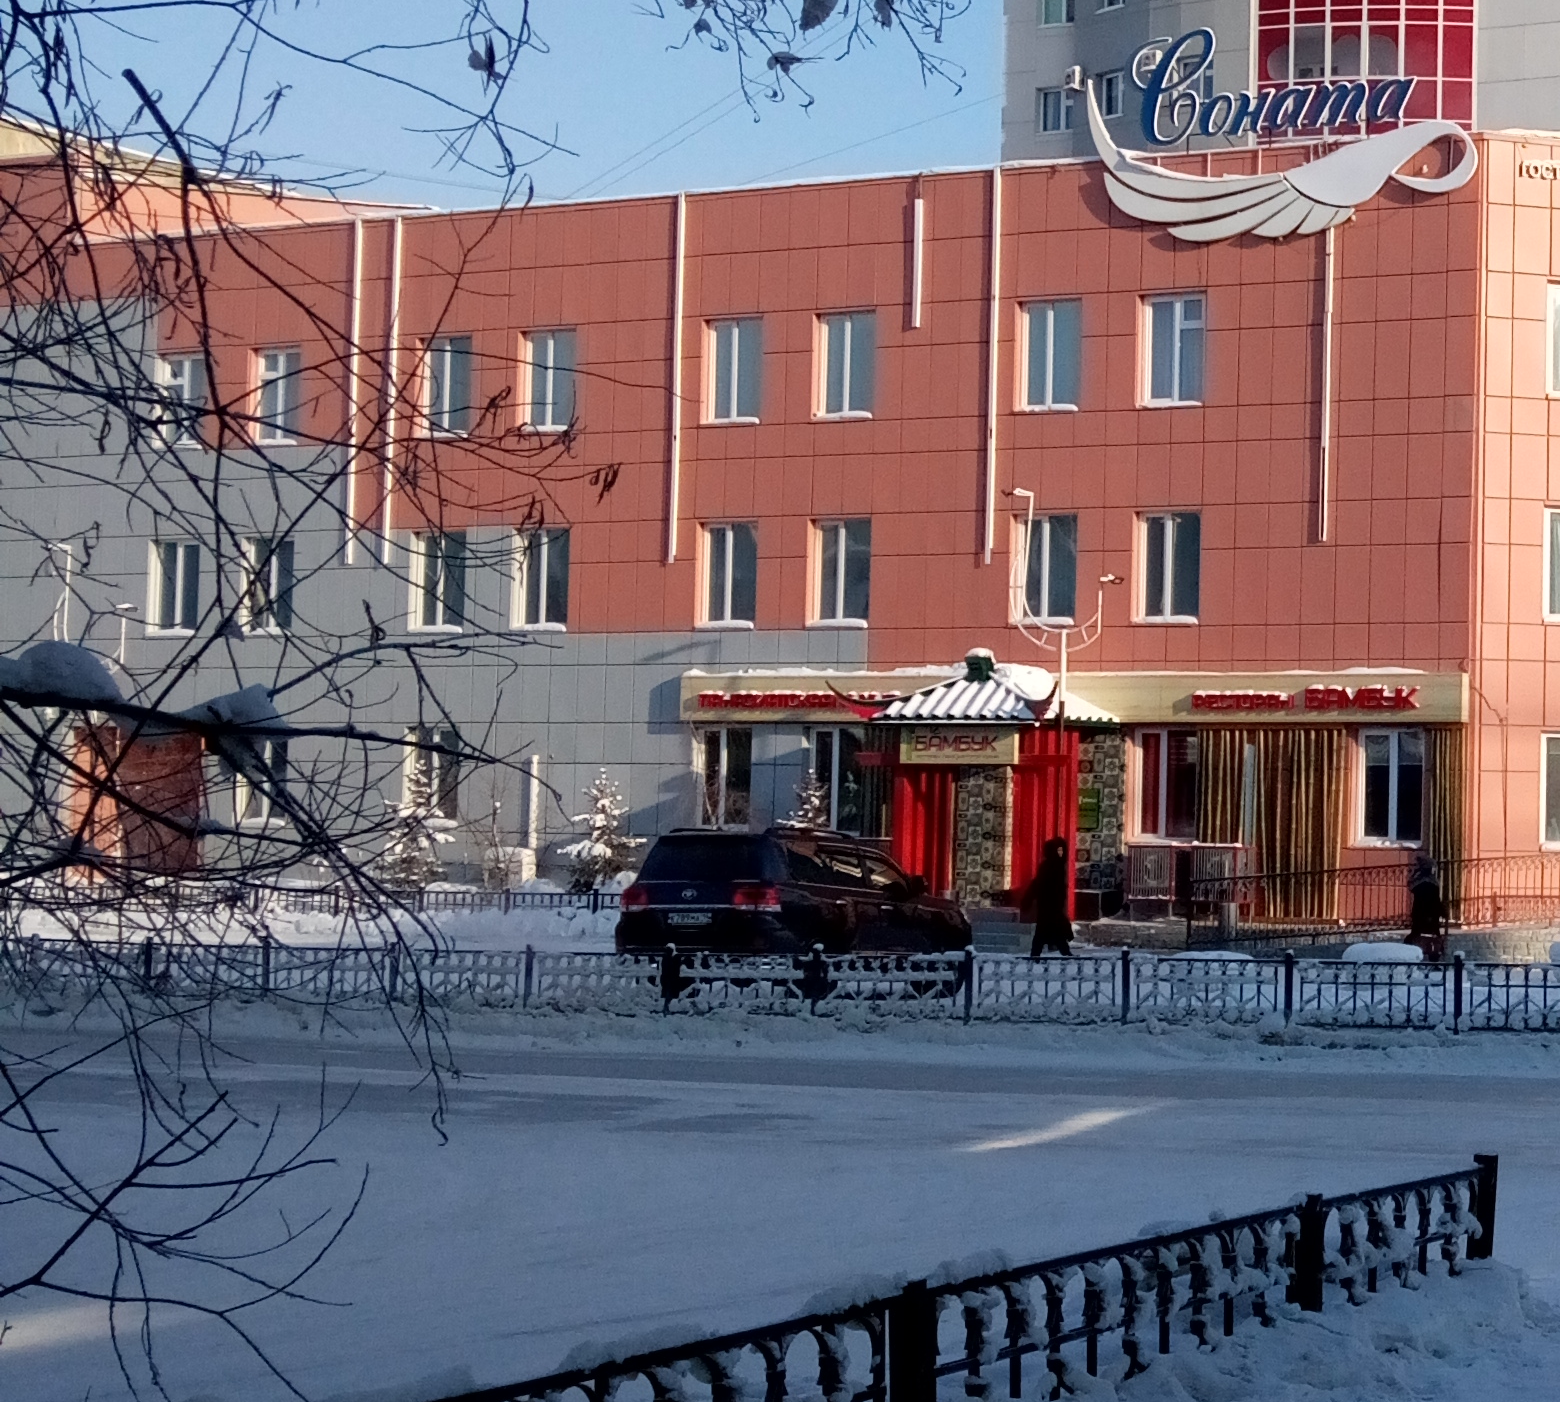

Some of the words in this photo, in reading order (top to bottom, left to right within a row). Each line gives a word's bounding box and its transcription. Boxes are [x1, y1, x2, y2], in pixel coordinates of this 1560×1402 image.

[1130, 27, 1417, 146] Соната
[1191, 690, 1294, 709] РЕСТОРАН
[1304, 684, 1420, 709] БАМБУК
[914, 735, 998, 752] БАМБУК
